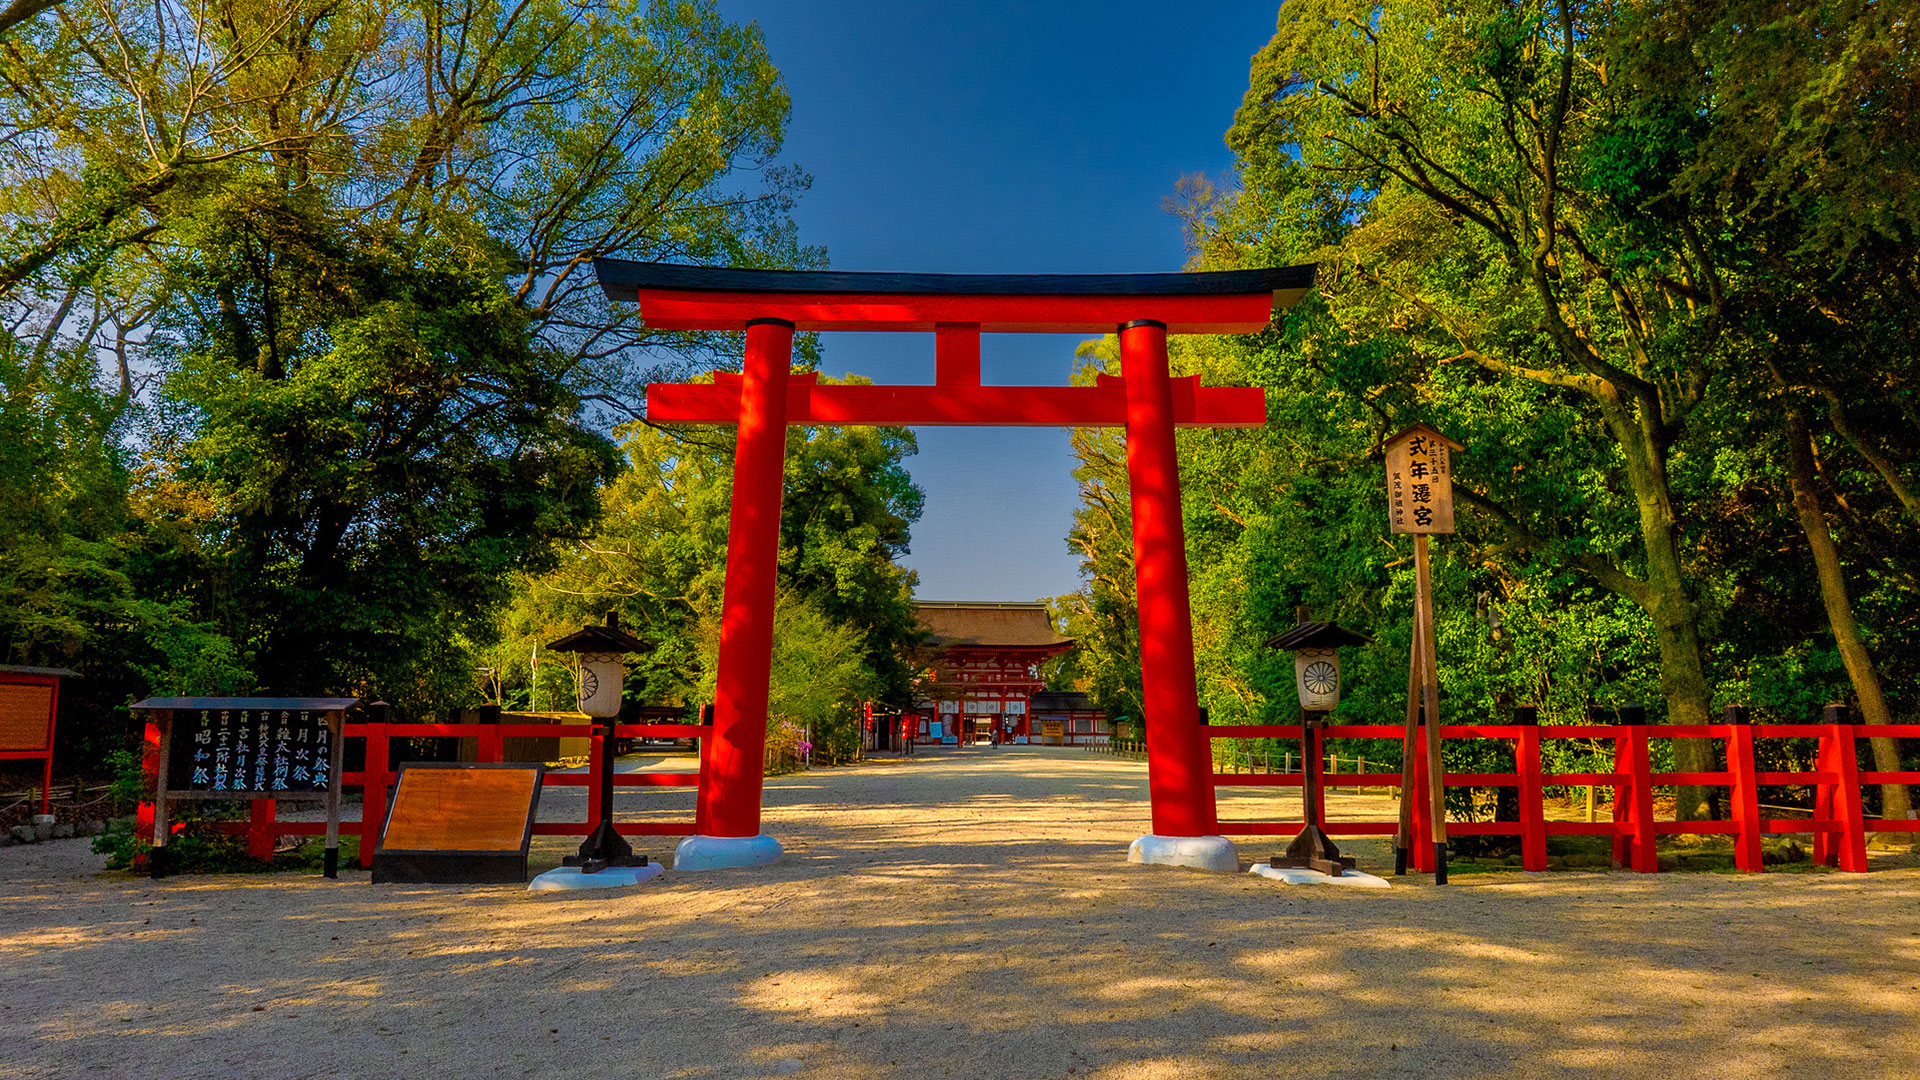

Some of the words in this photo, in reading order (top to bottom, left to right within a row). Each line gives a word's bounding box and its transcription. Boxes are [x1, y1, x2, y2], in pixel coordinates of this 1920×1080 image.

[1393, 472, 1405, 525] 賀茂御祖神社
[1409, 435, 1433, 527] 式年遷宮
[312, 717, 330, 790] 四月の祭典
